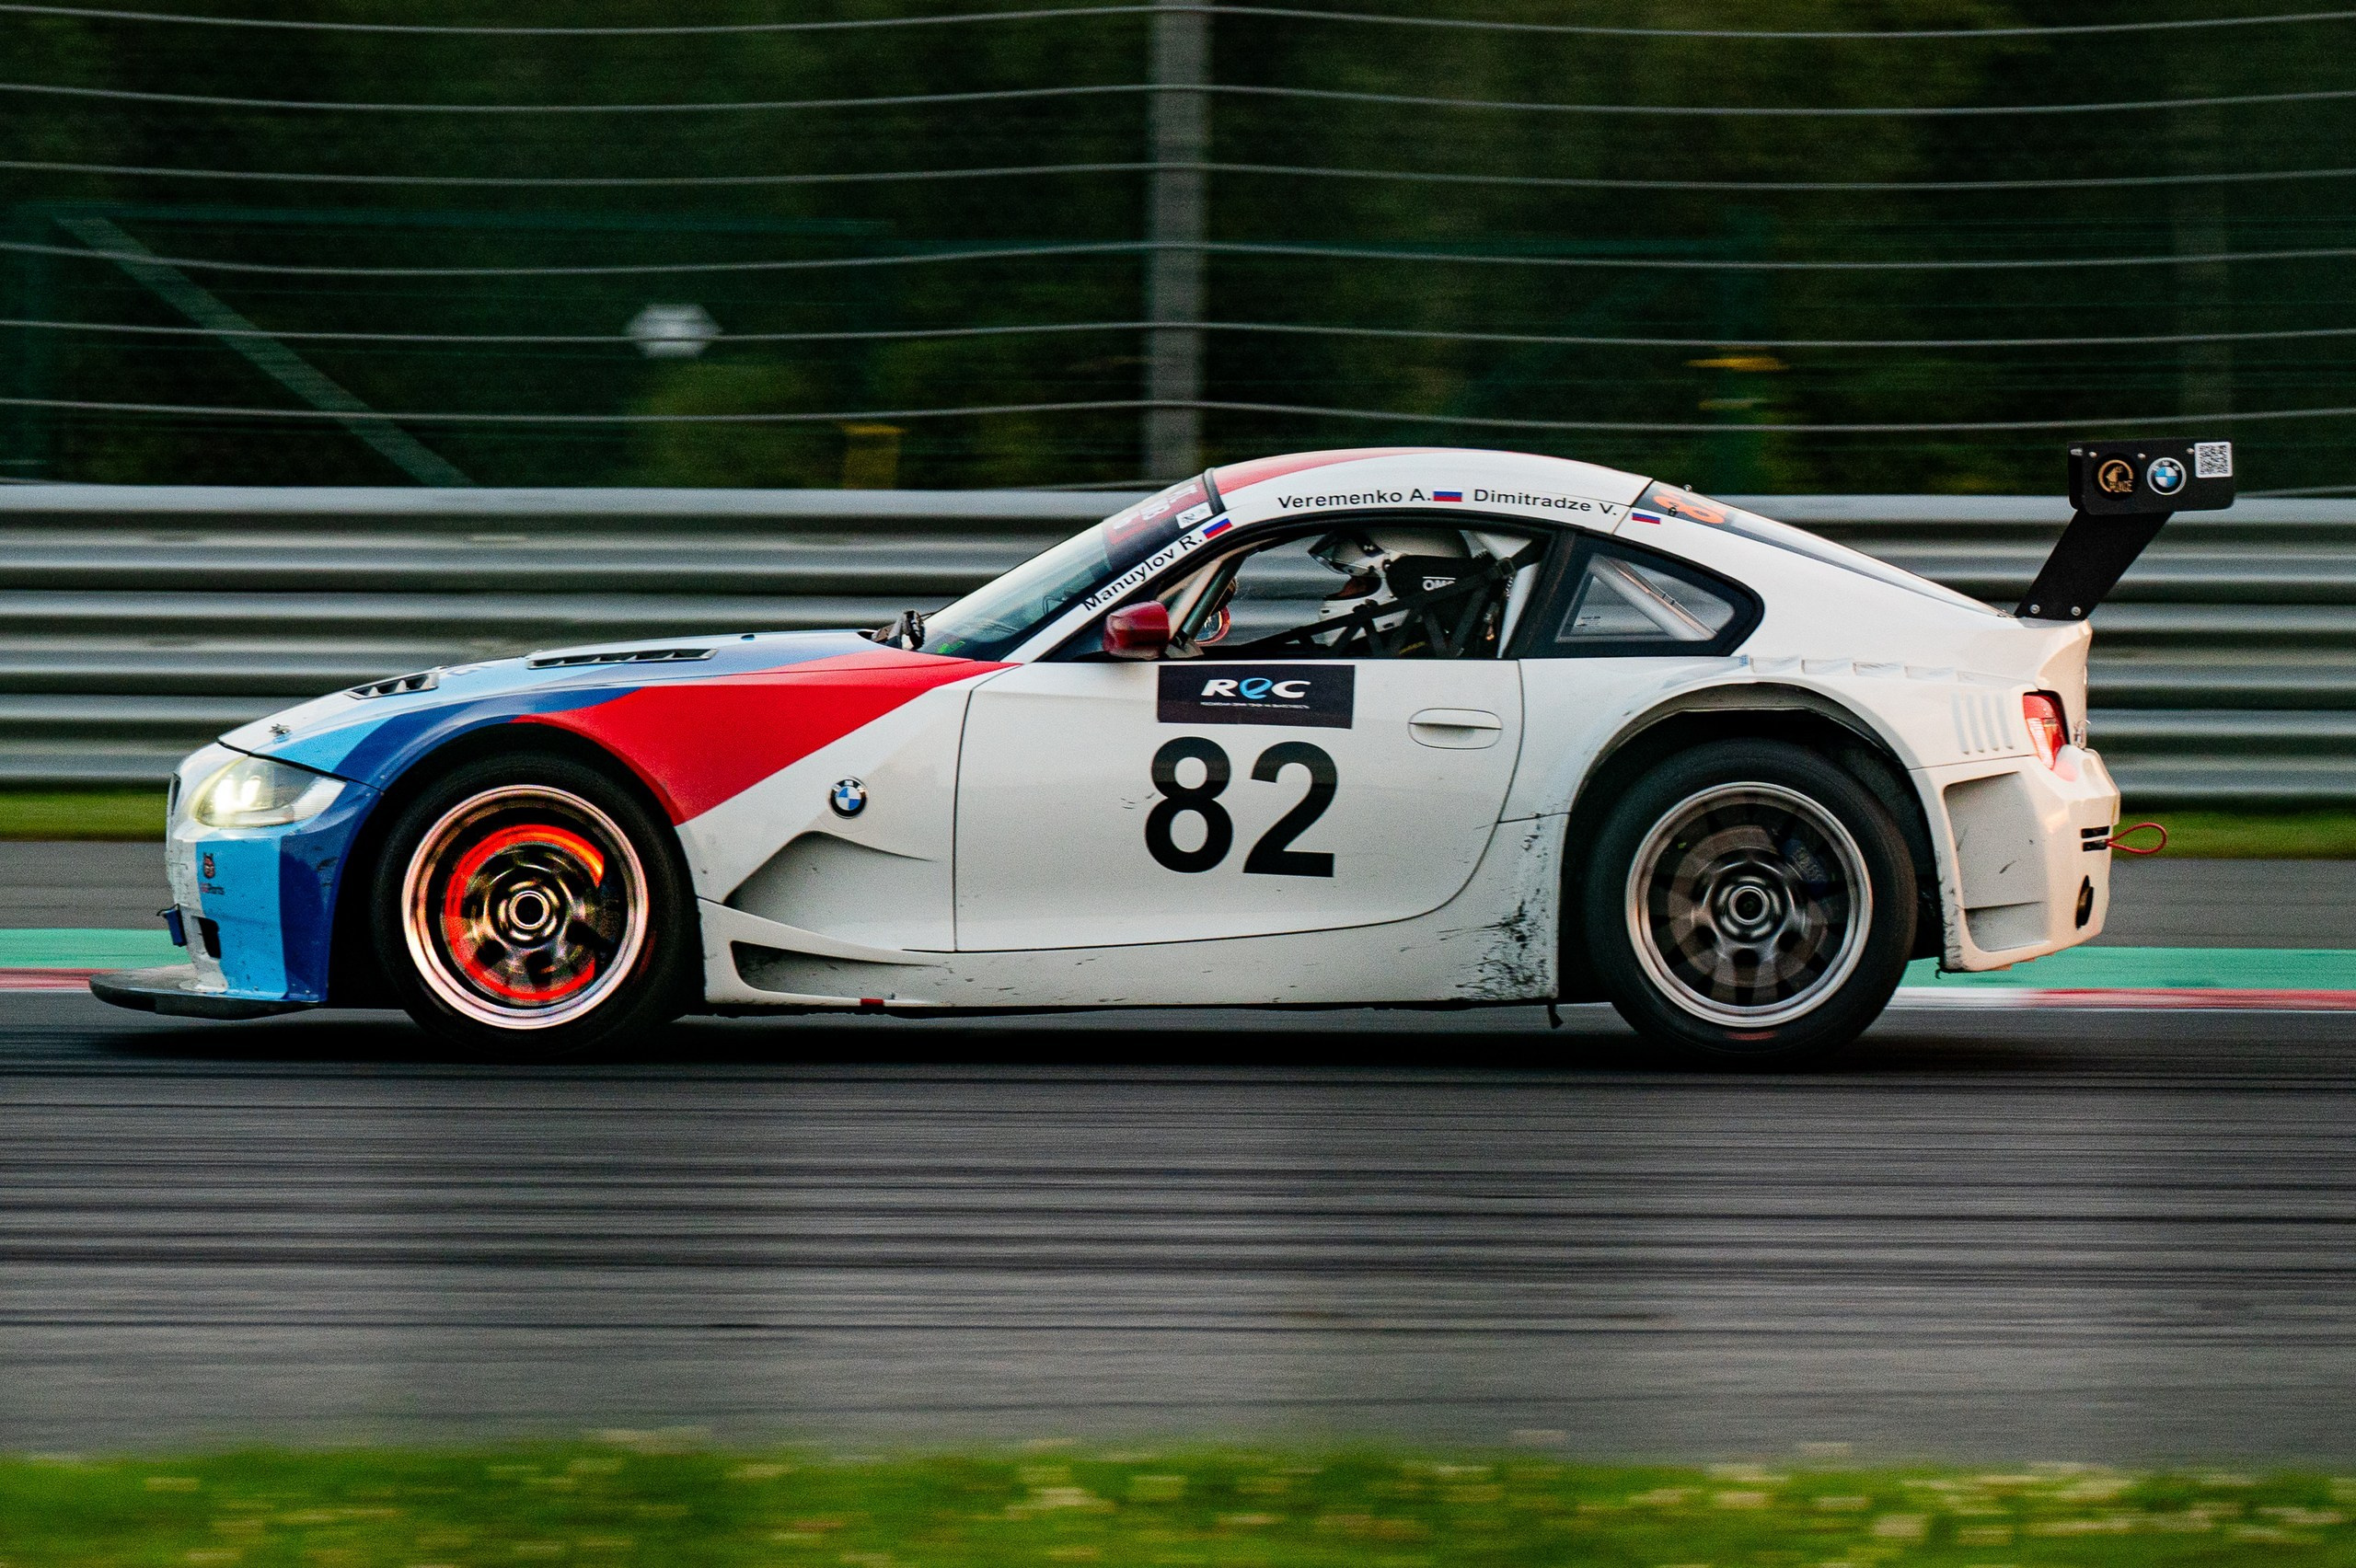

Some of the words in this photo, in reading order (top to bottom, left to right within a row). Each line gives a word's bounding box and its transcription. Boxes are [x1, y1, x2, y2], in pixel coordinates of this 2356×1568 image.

[1277, 489, 1403, 509] Veremenko
[1409, 488, 1432, 502] A.
[1473, 488, 1592, 513] Dimitradze
[1599, 502, 1618, 516] V.
[1080, 548, 1175, 612] Manuylov
[1178, 535, 1204, 551] R.
[1145, 736, 1338, 878] 82
